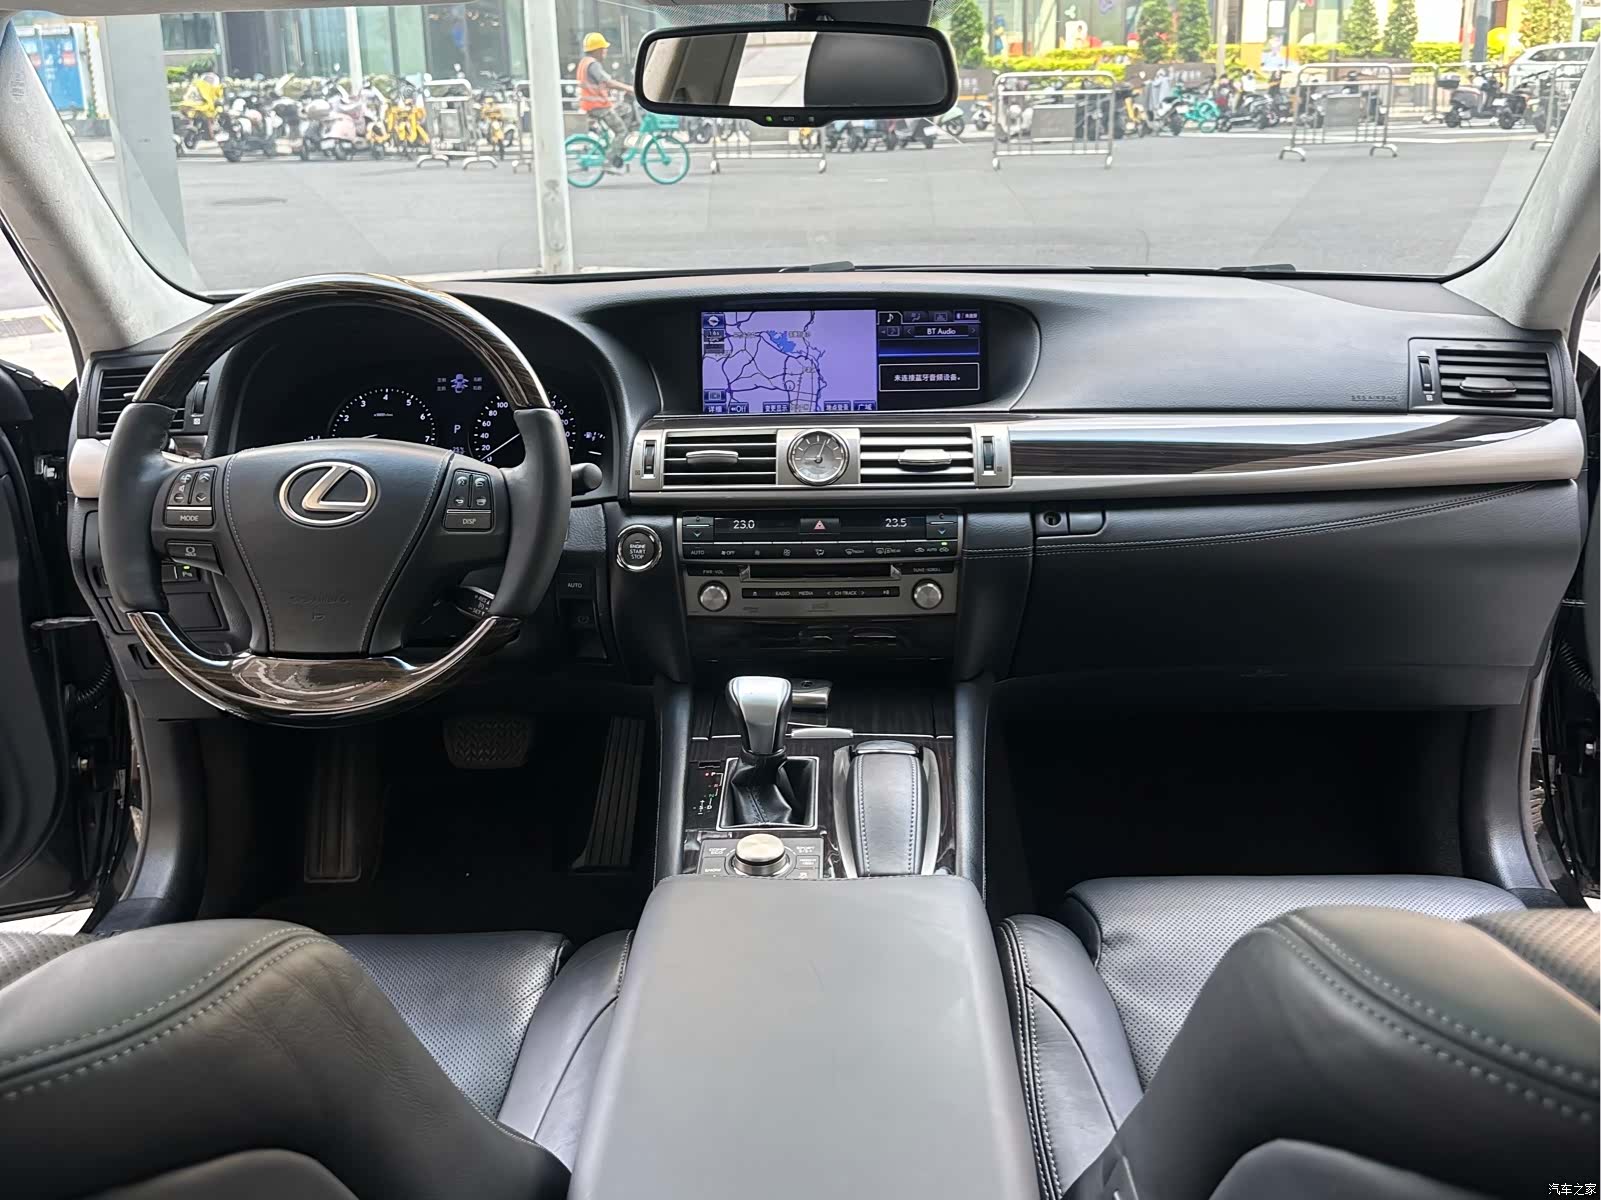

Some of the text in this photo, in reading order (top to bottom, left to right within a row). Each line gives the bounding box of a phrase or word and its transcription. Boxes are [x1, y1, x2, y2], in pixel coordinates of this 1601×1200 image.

[937, 327, 957, 335] Audio
[382, 393, 389, 401] 4
[360, 400, 367, 408] 3
[406, 399, 412, 407] 5
[496, 401, 509, 409] 100
[736, 404, 747, 412] Off
[343, 414, 350, 422] 2
[419, 413, 426, 421] 6
[453, 424, 461, 434] P
[424, 435, 431, 443] 7
[180, 514, 200, 522] MODE
[733, 519, 755, 530] 23.0
[885, 517, 907, 528] 23.5
